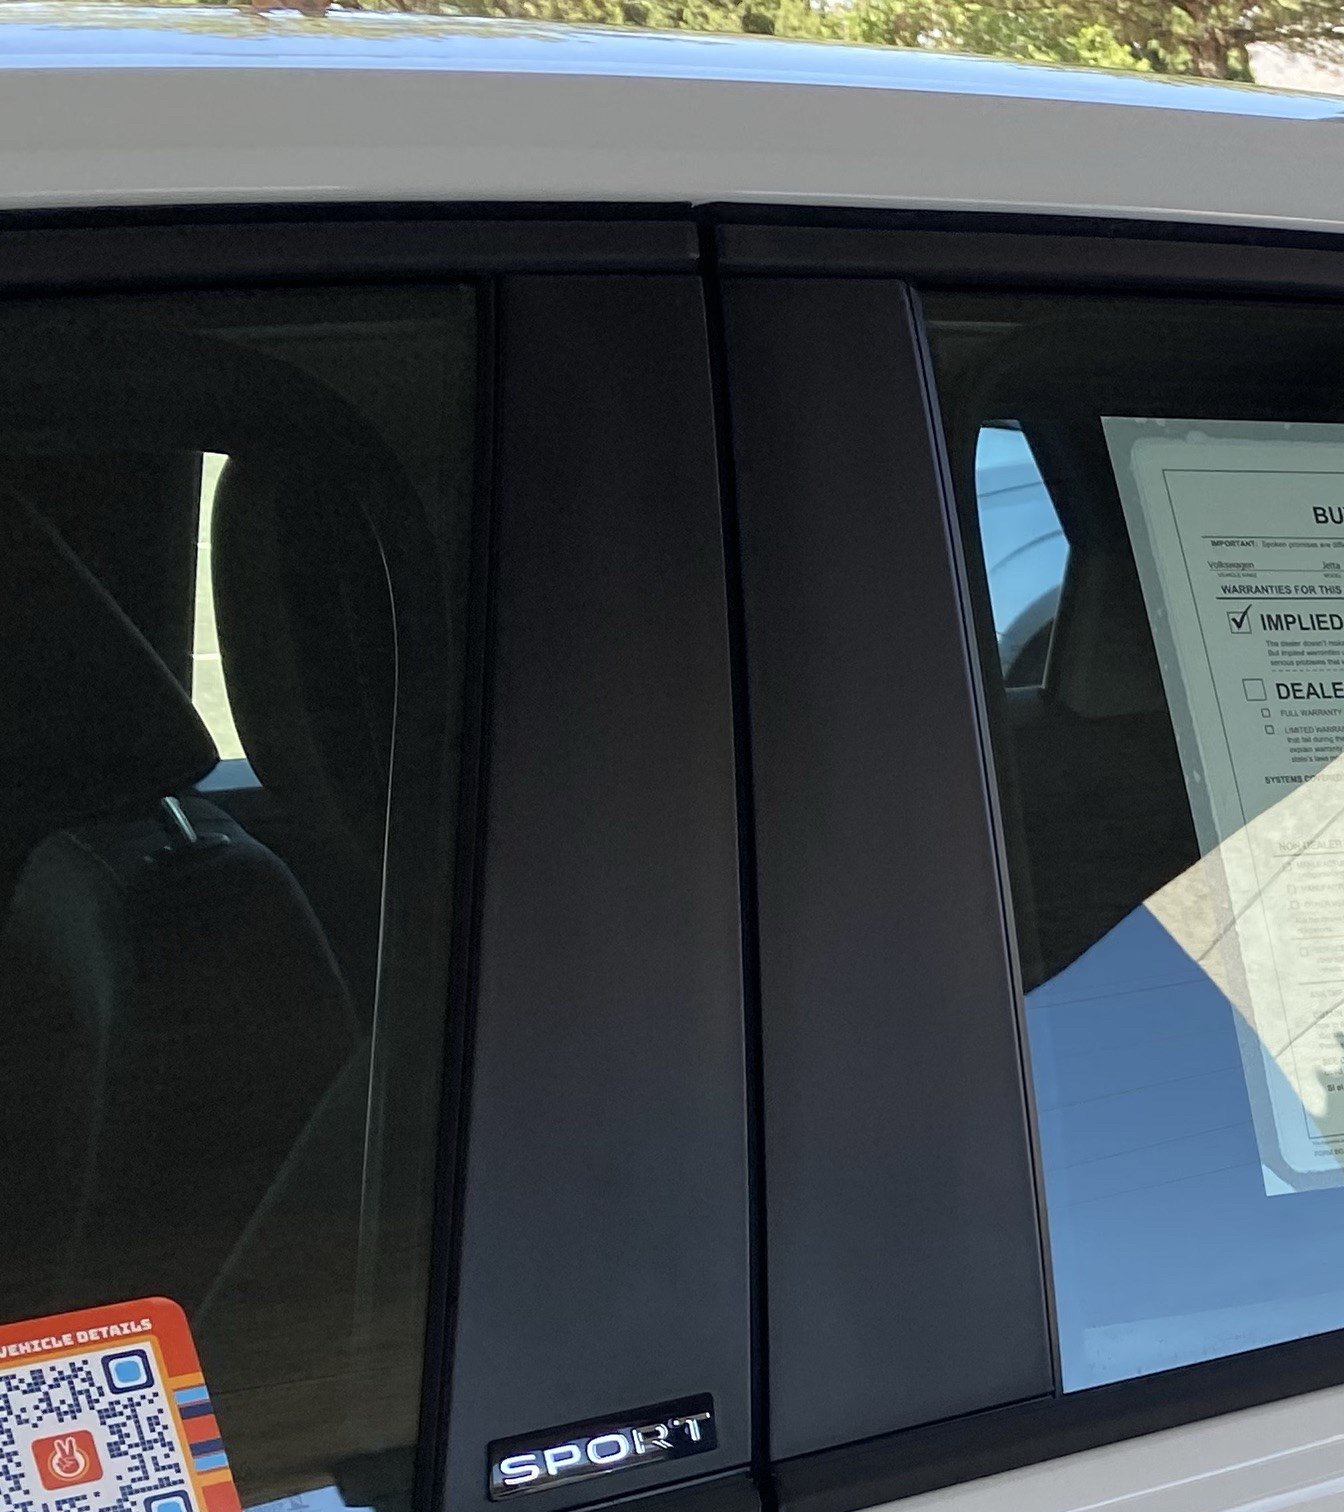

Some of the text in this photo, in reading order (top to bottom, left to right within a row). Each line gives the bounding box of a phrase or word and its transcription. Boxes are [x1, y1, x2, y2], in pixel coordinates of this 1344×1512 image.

[1323, 562, 1341, 570] Jetta
[1221, 585, 1292, 594] WARRANTIES
[1294, 585, 1317, 594] FOR
[1320, 585, 1342, 594] THIS
[1260, 614, 1344, 631] IMPLIED
[0, 1318, 152, 1358] VEHICLE DETAILS
[500, 1411, 712, 1486] SPORT
